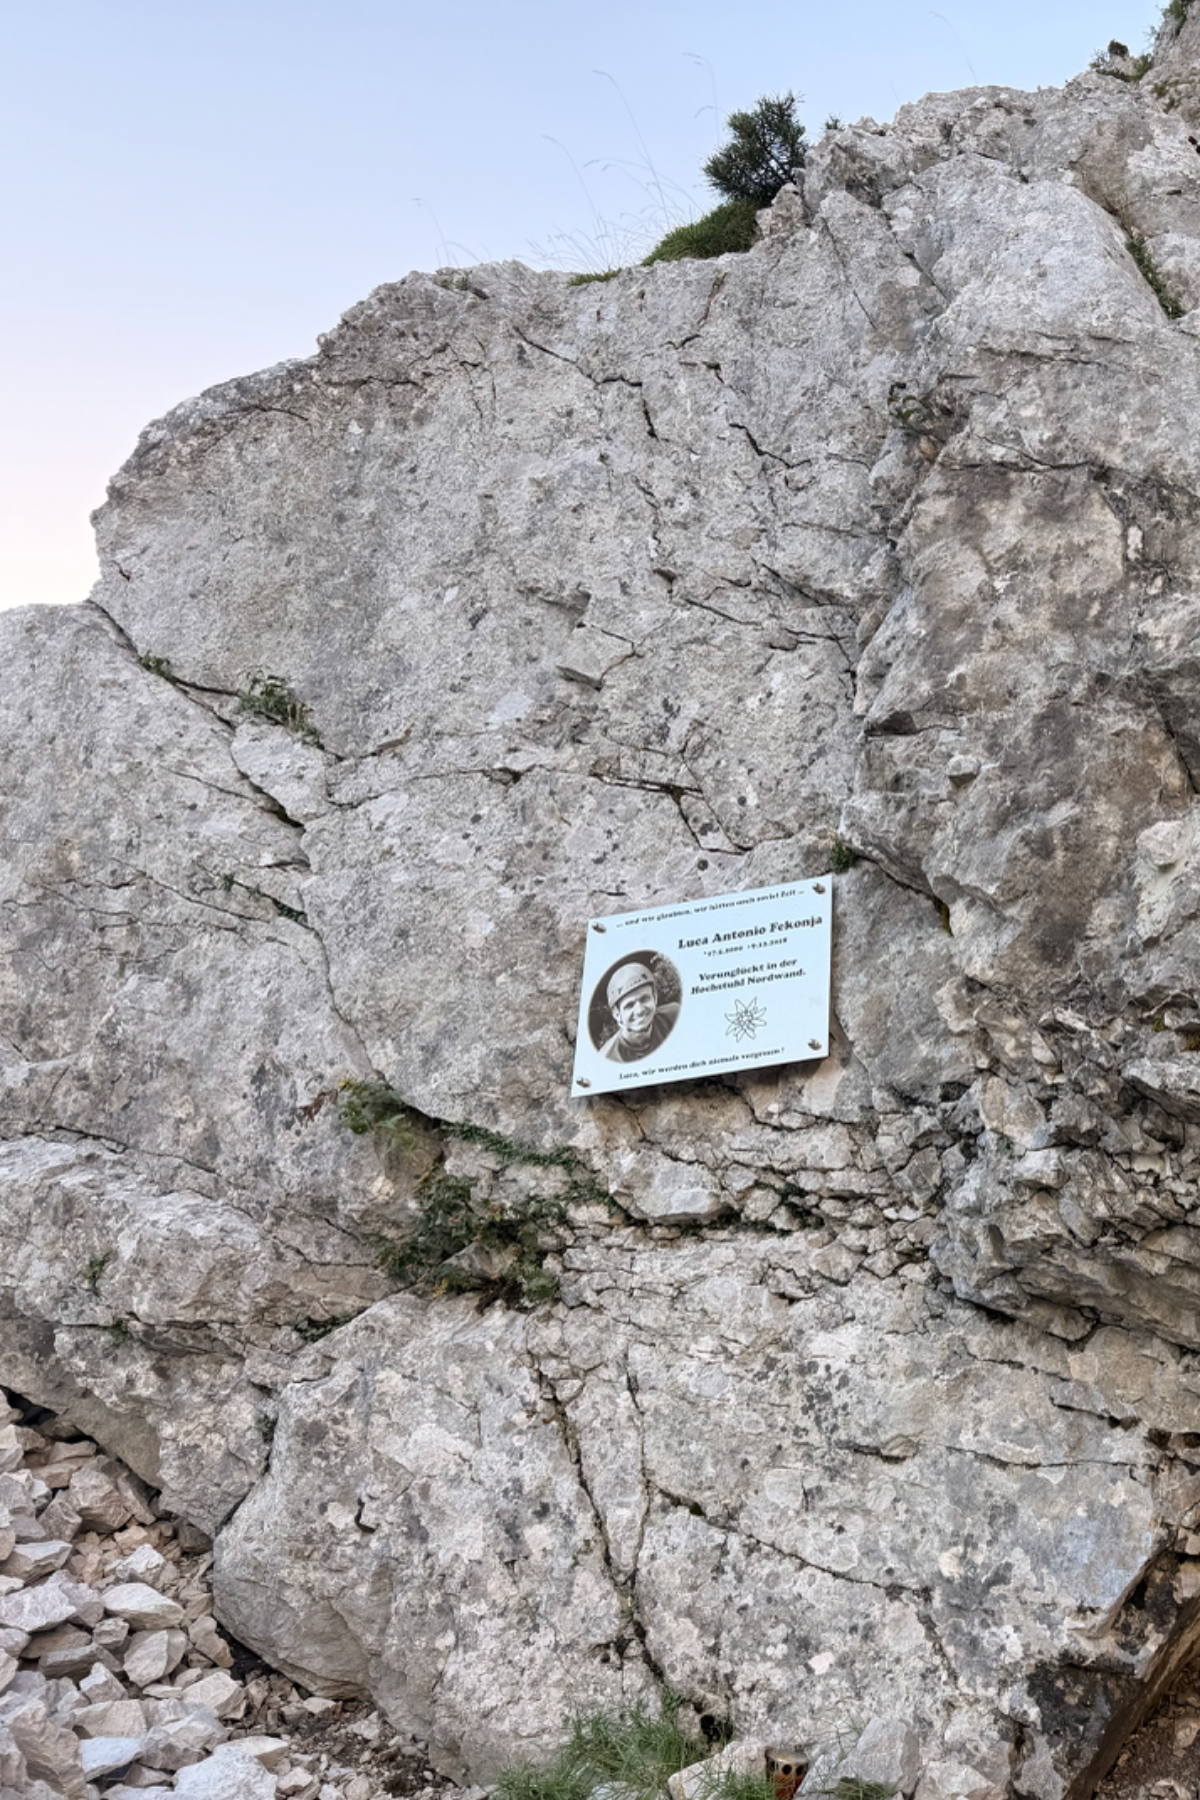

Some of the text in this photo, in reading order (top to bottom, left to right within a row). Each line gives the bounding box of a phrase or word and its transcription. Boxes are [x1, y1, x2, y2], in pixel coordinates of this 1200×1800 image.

[625, 917, 640, 926] und
[641, 915, 655, 923] wir
[694, 906, 708, 914] wir
[780, 889, 797, 899] Zeit
[678, 915, 823, 950] Luca Antonio Fekonja
[690, 968, 806, 995] Hochstuhl Nordwand.
[698, 958, 798, 982] Verunglückt in der
[619, 1071, 640, 1080] Luca,
[641, 1067, 657, 1076] wir
[658, 1063, 688, 1074] werden
[689, 1059, 707, 1069] dich
[708, 1054, 740, 1066] niemals
